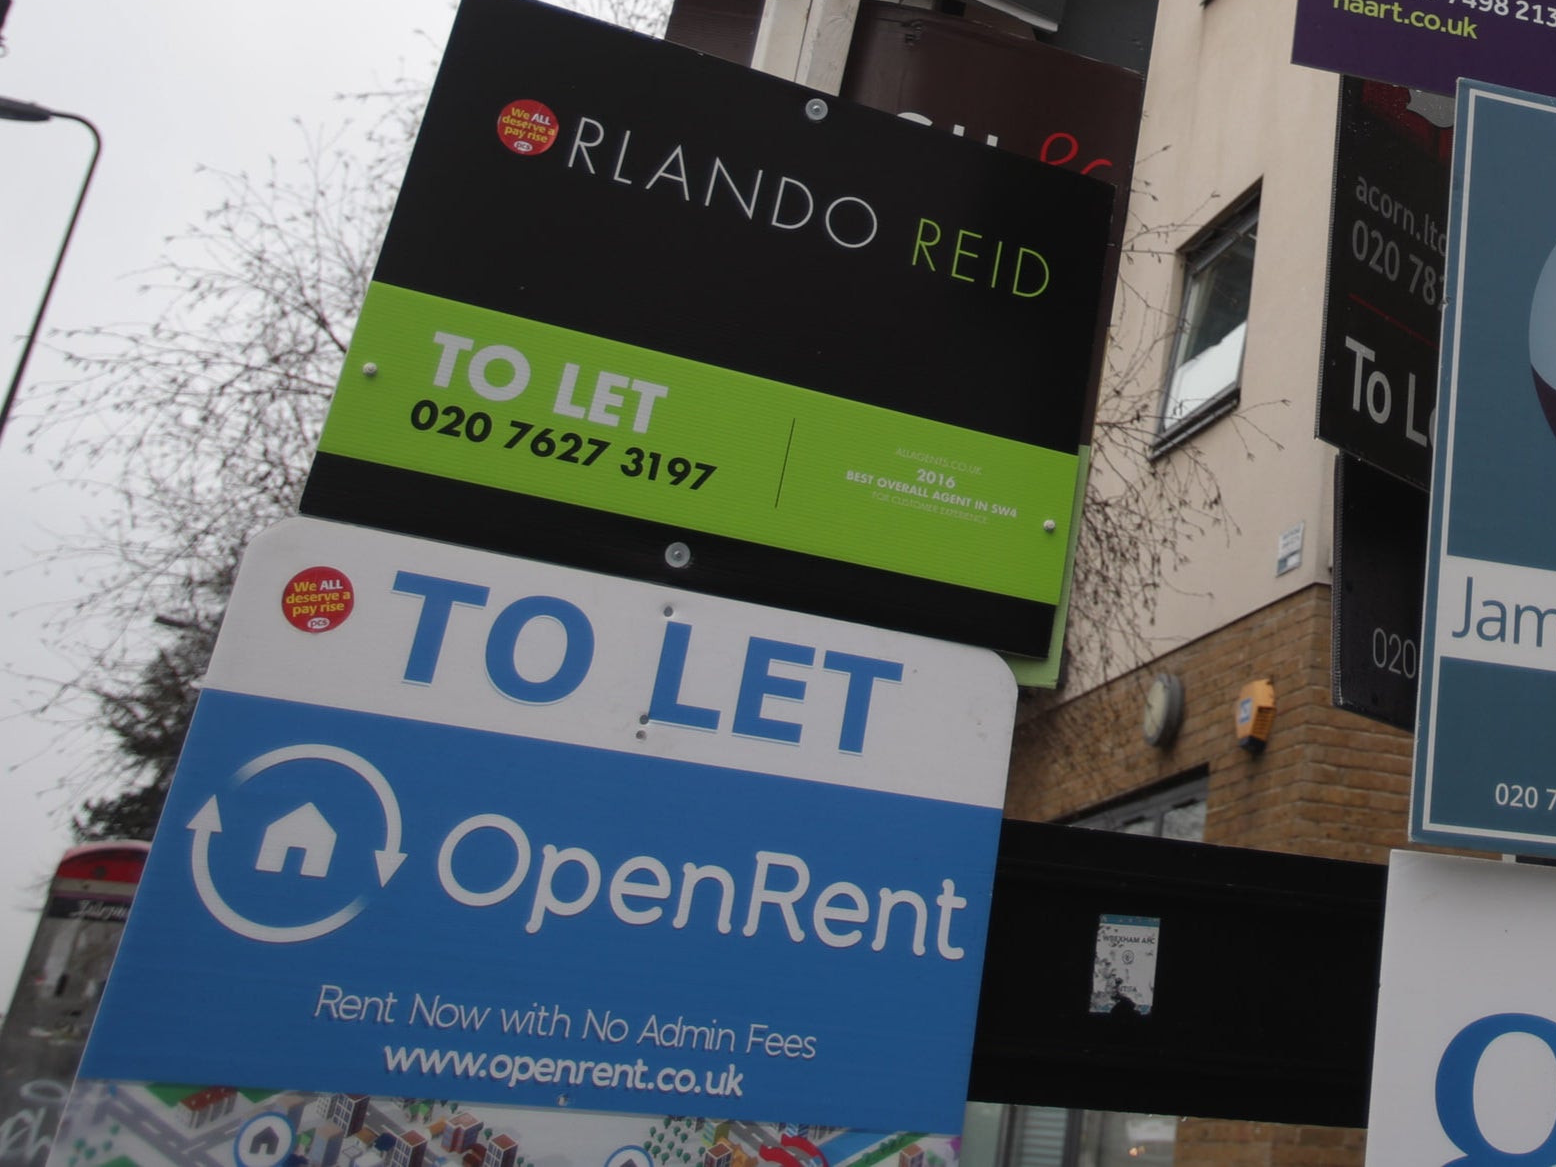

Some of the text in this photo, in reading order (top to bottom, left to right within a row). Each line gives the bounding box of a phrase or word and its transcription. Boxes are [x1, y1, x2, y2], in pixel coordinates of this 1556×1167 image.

[502, 115, 545, 133] deserve
[505, 127, 548, 143] pay rise
[512, 107, 551, 125] We ALL
[568, 117, 1051, 300] RLANDO REID
[1352, 220, 1400, 282] 020
[433, 331, 669, 435] TO LET
[1345, 335, 1392, 425] To
[410, 398, 718, 492] 020 7627 3197
[847, 470, 1017, 518] BEST OVERALL AGENT IN SW4
[917, 468, 956, 489] 2016
[286, 591, 351, 604] deserve a
[292, 602, 344, 617] pay rise
[294, 579, 344, 592] We ALL
[392, 570, 905, 756] TO LET
[1372, 628, 1417, 679] 020
[1494, 782, 1540, 811] 020
[438, 812, 968, 962] OpenRent
[314, 984, 818, 1060] Rent Now with No Admin Fees
[383, 1045, 744, 1100] www.openrent.co.uk
